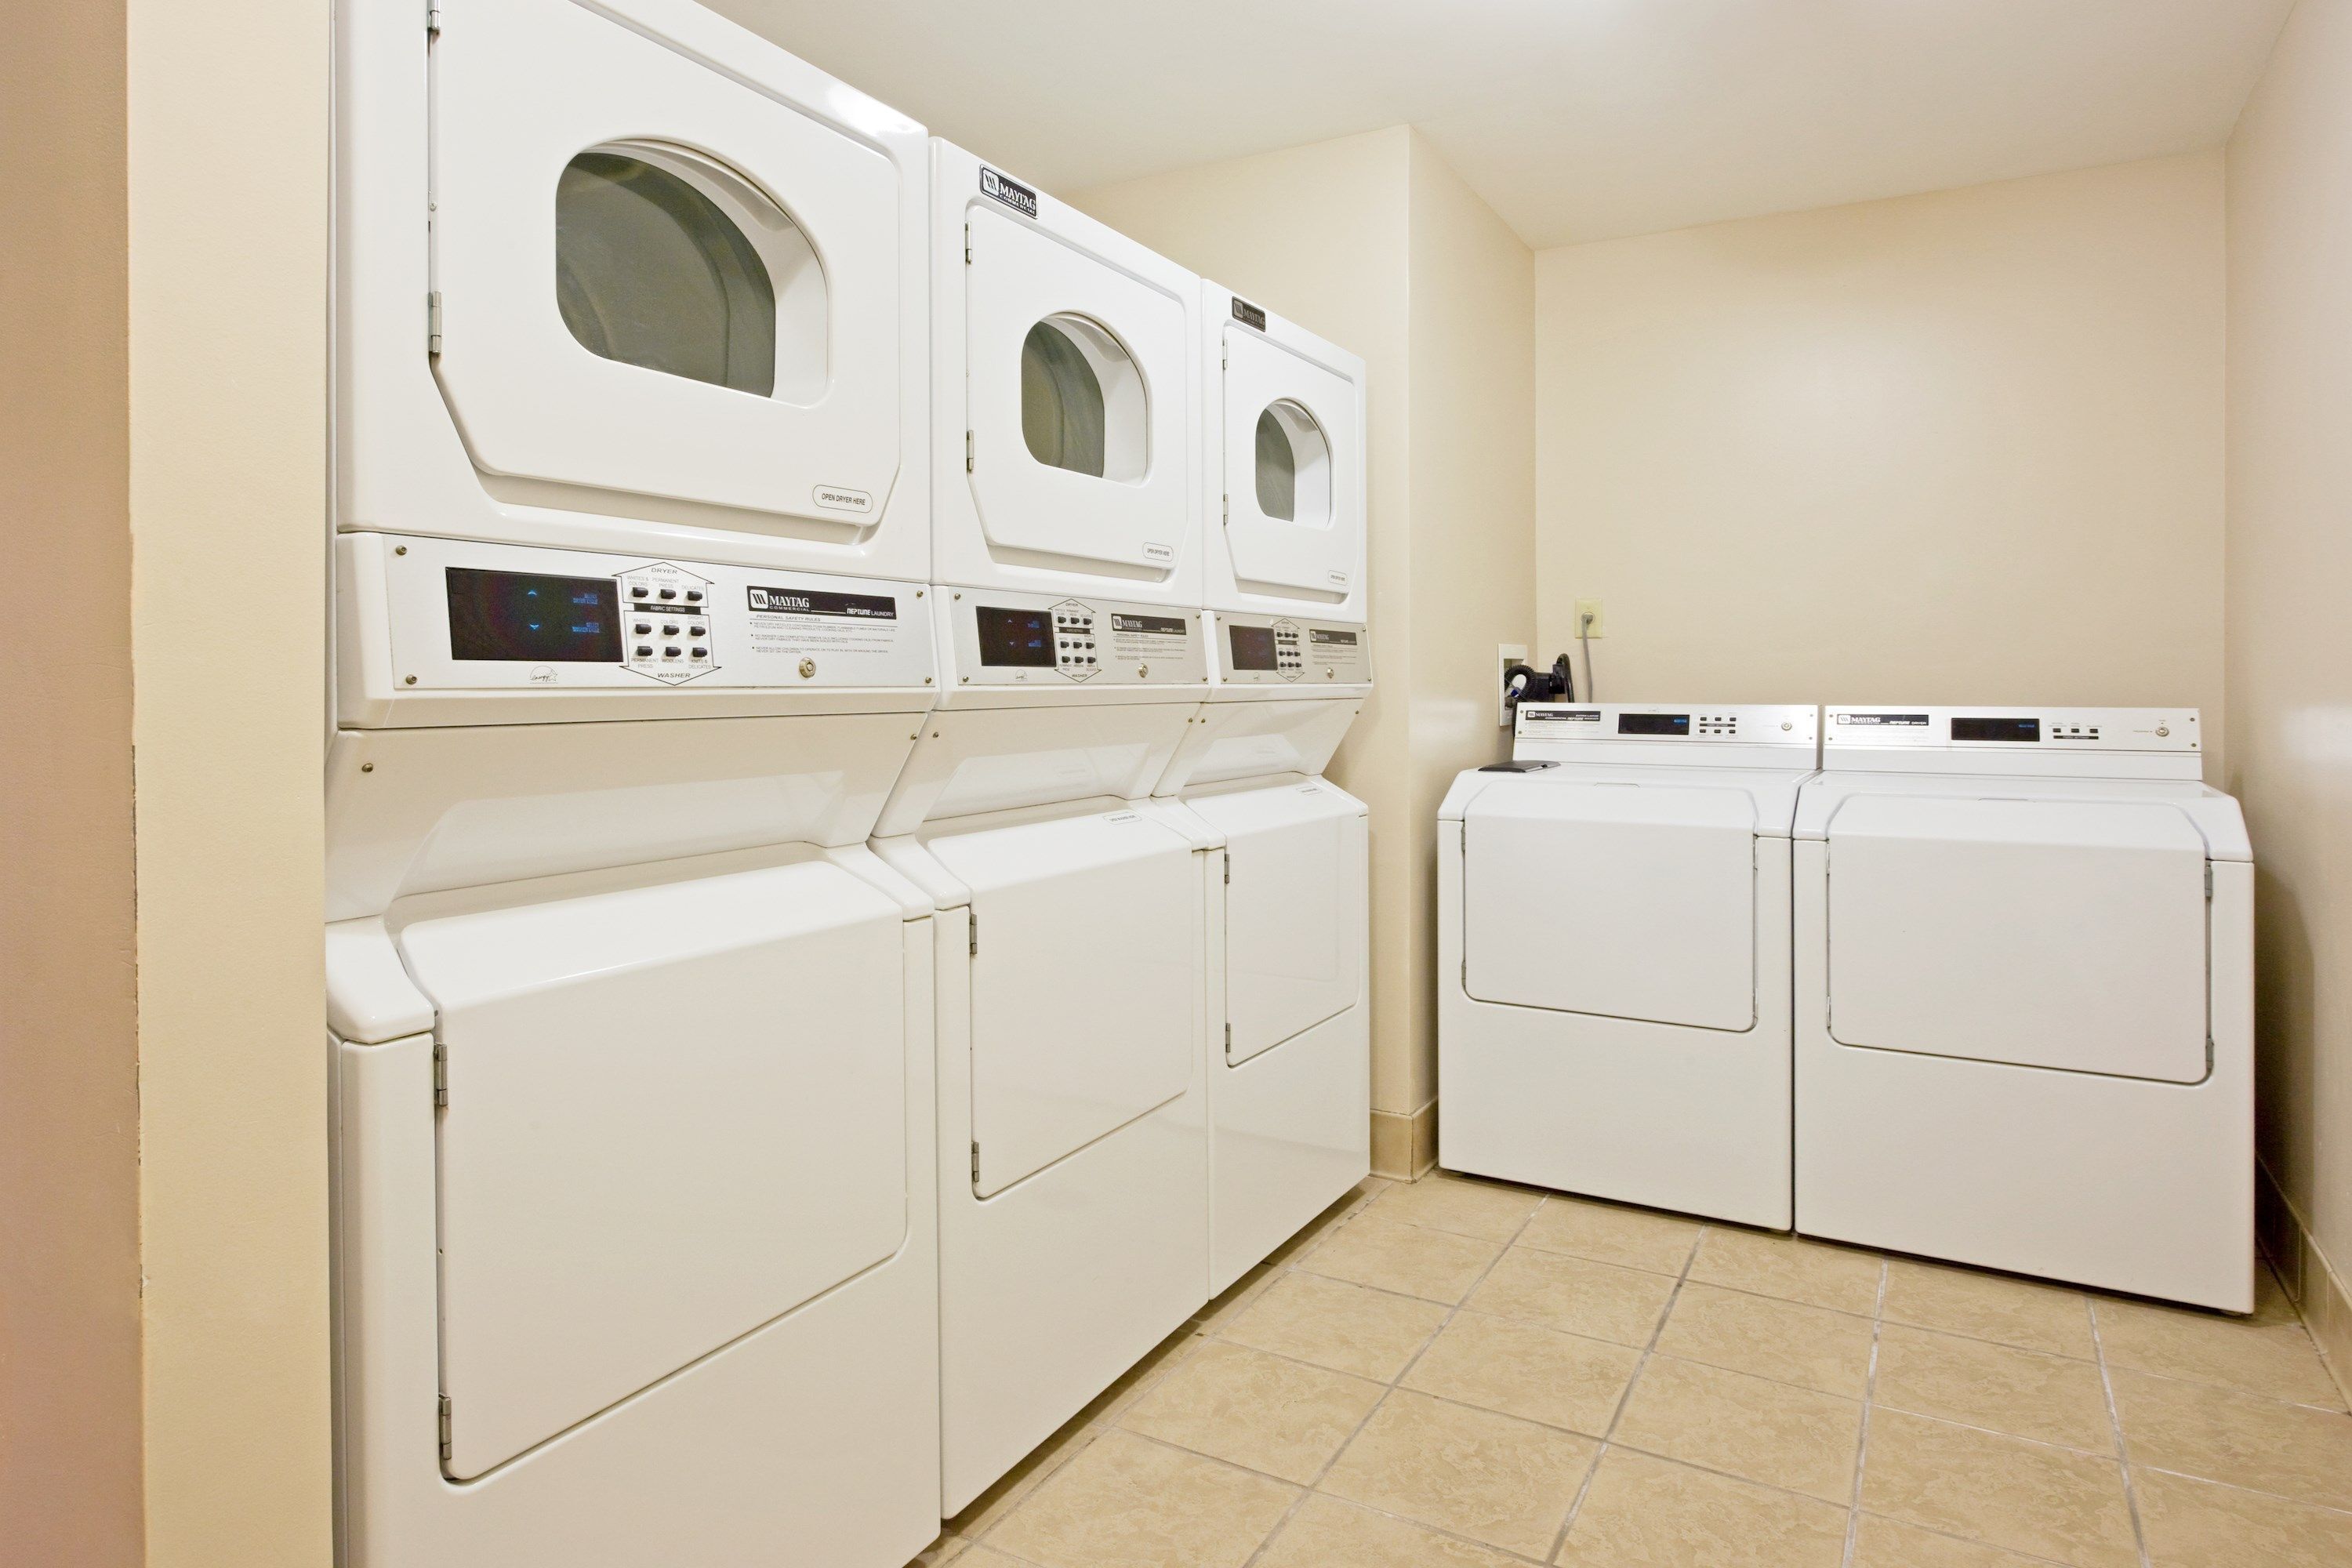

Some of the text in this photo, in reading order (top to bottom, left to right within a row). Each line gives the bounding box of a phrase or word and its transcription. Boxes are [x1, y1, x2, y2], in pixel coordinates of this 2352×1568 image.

[1000, 183, 1035, 210] MAYTAG
[1000, 194, 1035, 215] COMMERCIAL
[822, 492, 835, 501] OPEN
[853, 497, 866, 506] HERE
[768, 595, 810, 608] MAYTAG
[1122, 619, 1143, 628] MAYTAG
